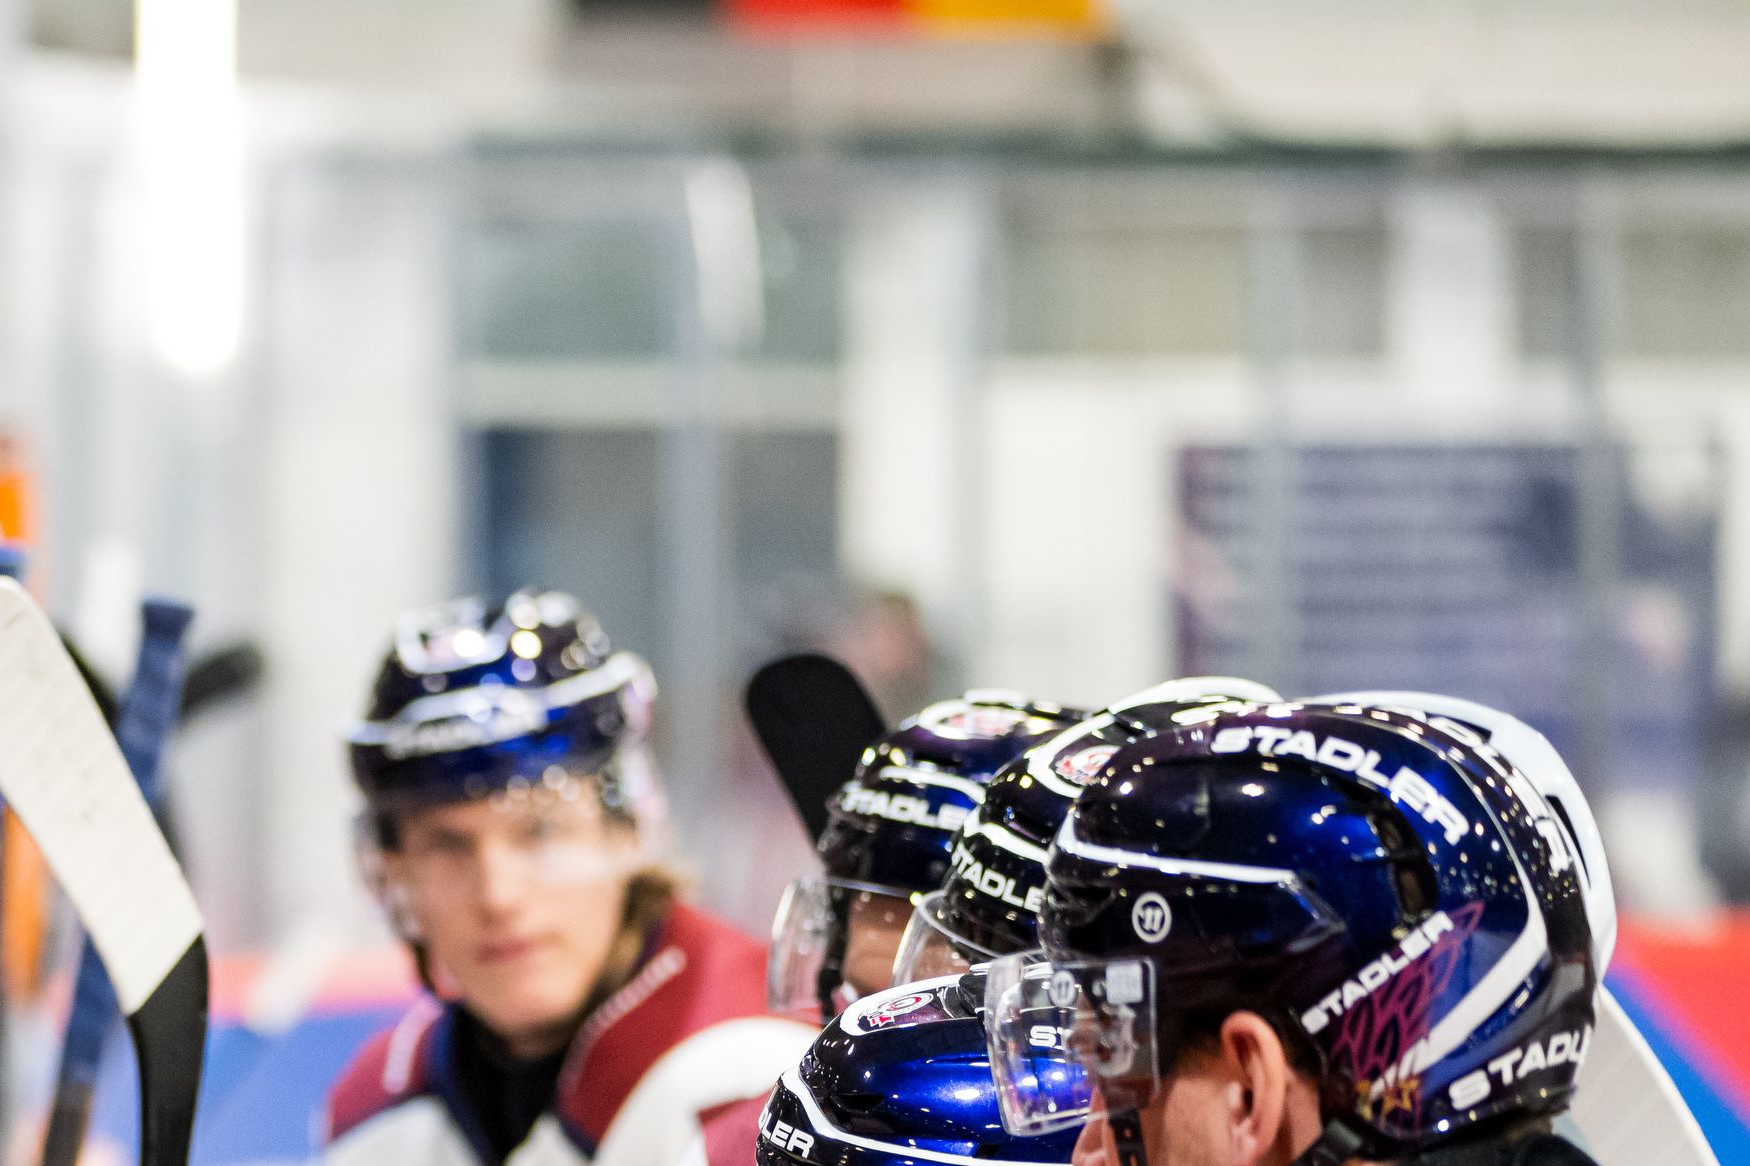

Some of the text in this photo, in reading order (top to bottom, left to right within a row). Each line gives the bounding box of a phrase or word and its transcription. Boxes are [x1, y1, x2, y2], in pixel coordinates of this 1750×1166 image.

[841, 785, 968, 831] STADLE
[1211, 725, 1470, 846] STADLER
[952, 842, 1046, 913] TADLE
[1301, 911, 1454, 1035] STADLER
